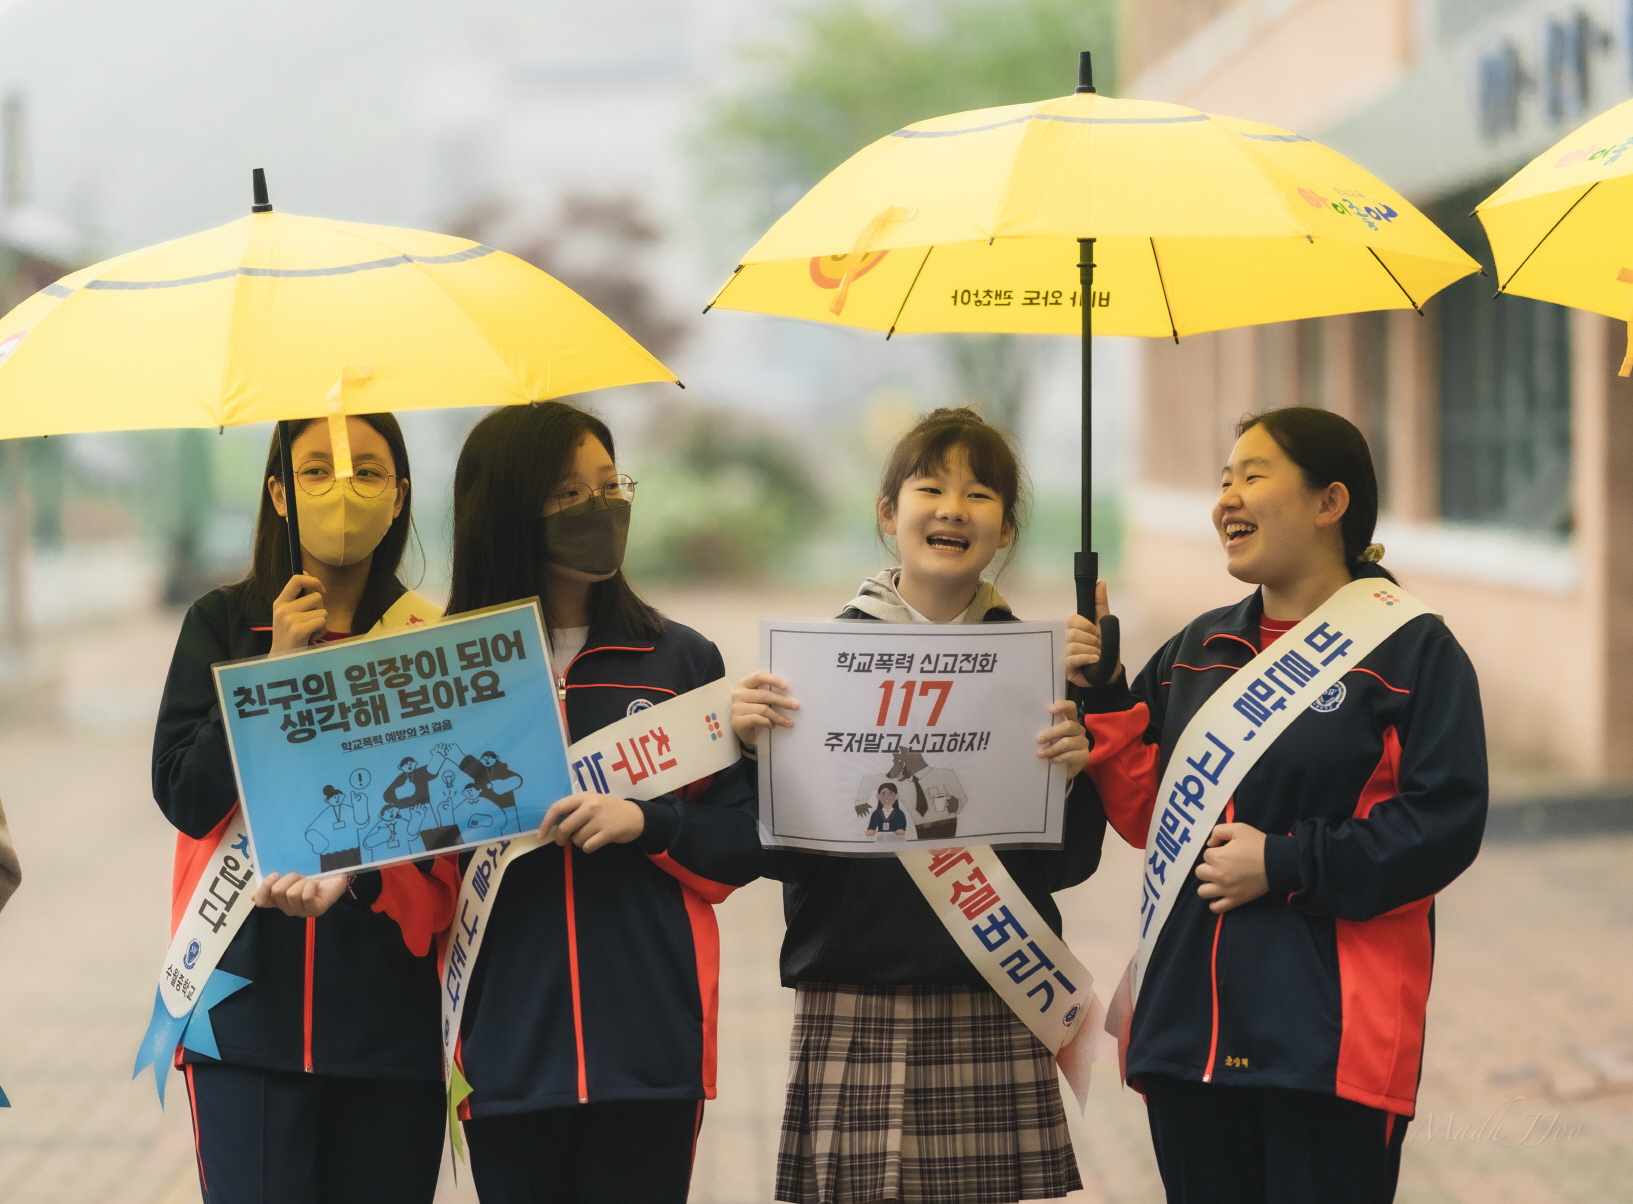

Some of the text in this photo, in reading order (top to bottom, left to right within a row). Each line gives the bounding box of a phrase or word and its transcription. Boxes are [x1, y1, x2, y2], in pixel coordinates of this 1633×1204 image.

[233, 629, 526, 719] 친구의 입장이 되어
[836, 651, 998, 674] 학교폭력 신고전화
[280, 669, 506, 744] 생각해 보아요
[875, 680, 954, 727] 117
[340, 718, 454, 753] 학교폭력 예방의 첫 걸음
[824, 731, 991, 754] 주저말고 신고하자!
